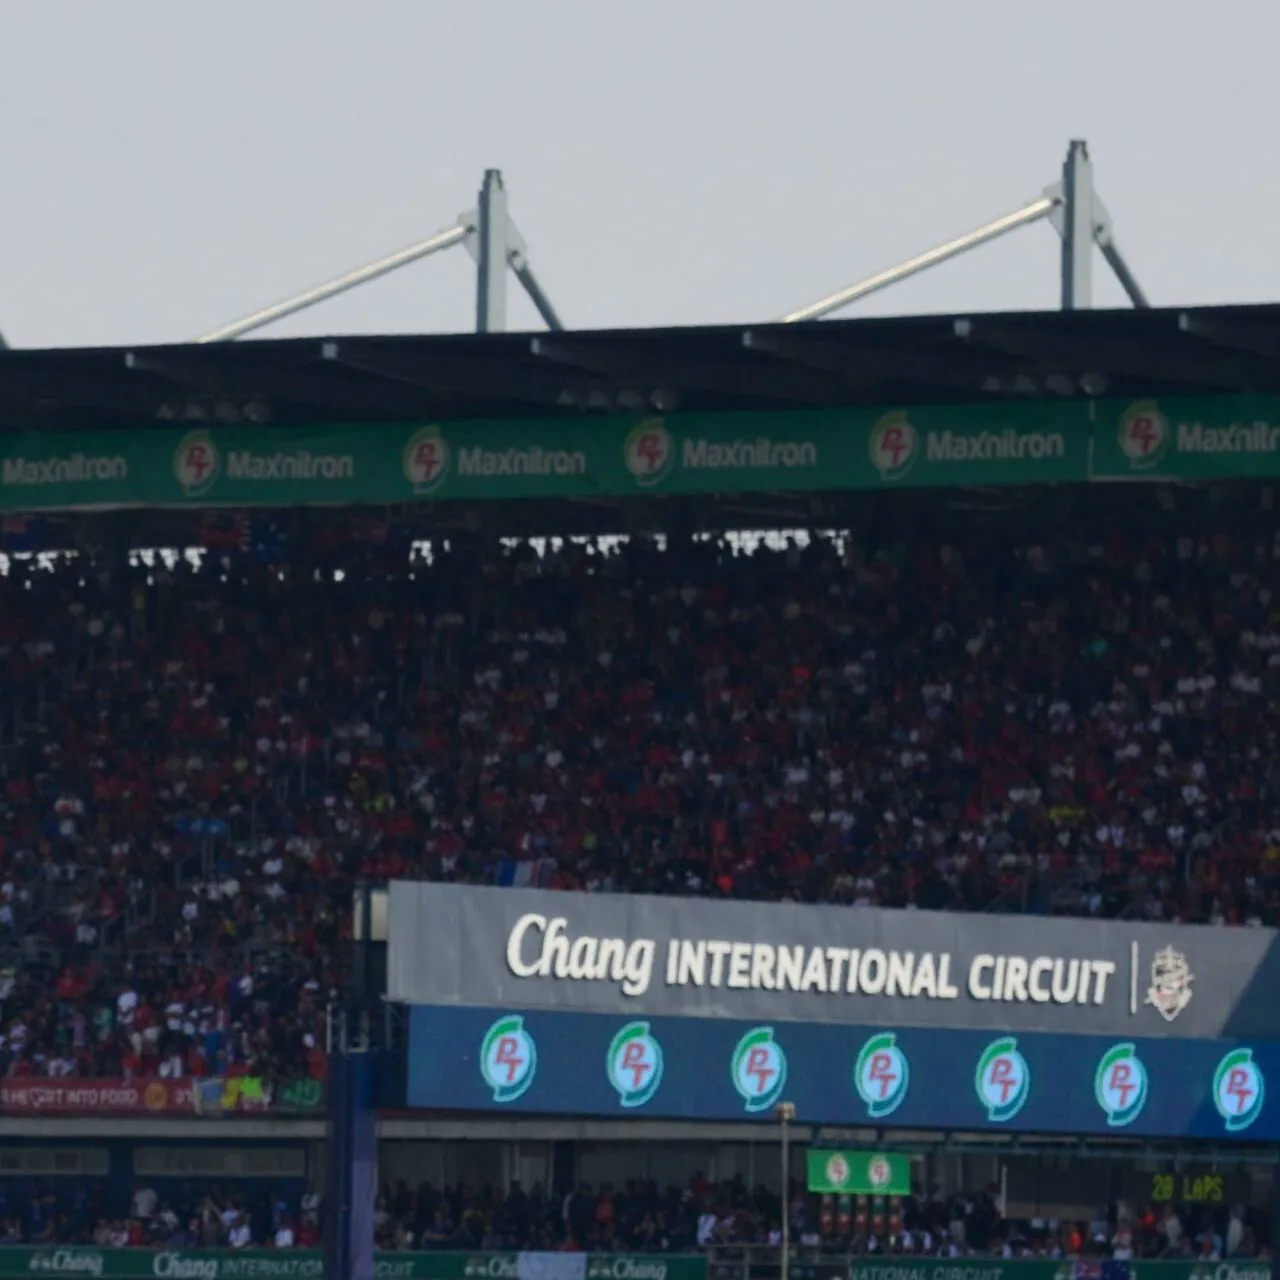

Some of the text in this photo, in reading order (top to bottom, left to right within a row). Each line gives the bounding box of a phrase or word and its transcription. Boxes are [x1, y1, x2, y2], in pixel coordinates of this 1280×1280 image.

[506, 913, 1115, 1005] Chang INTERNATIONAL CIRCUIT
[52, 1250, 103, 1276] Chang
